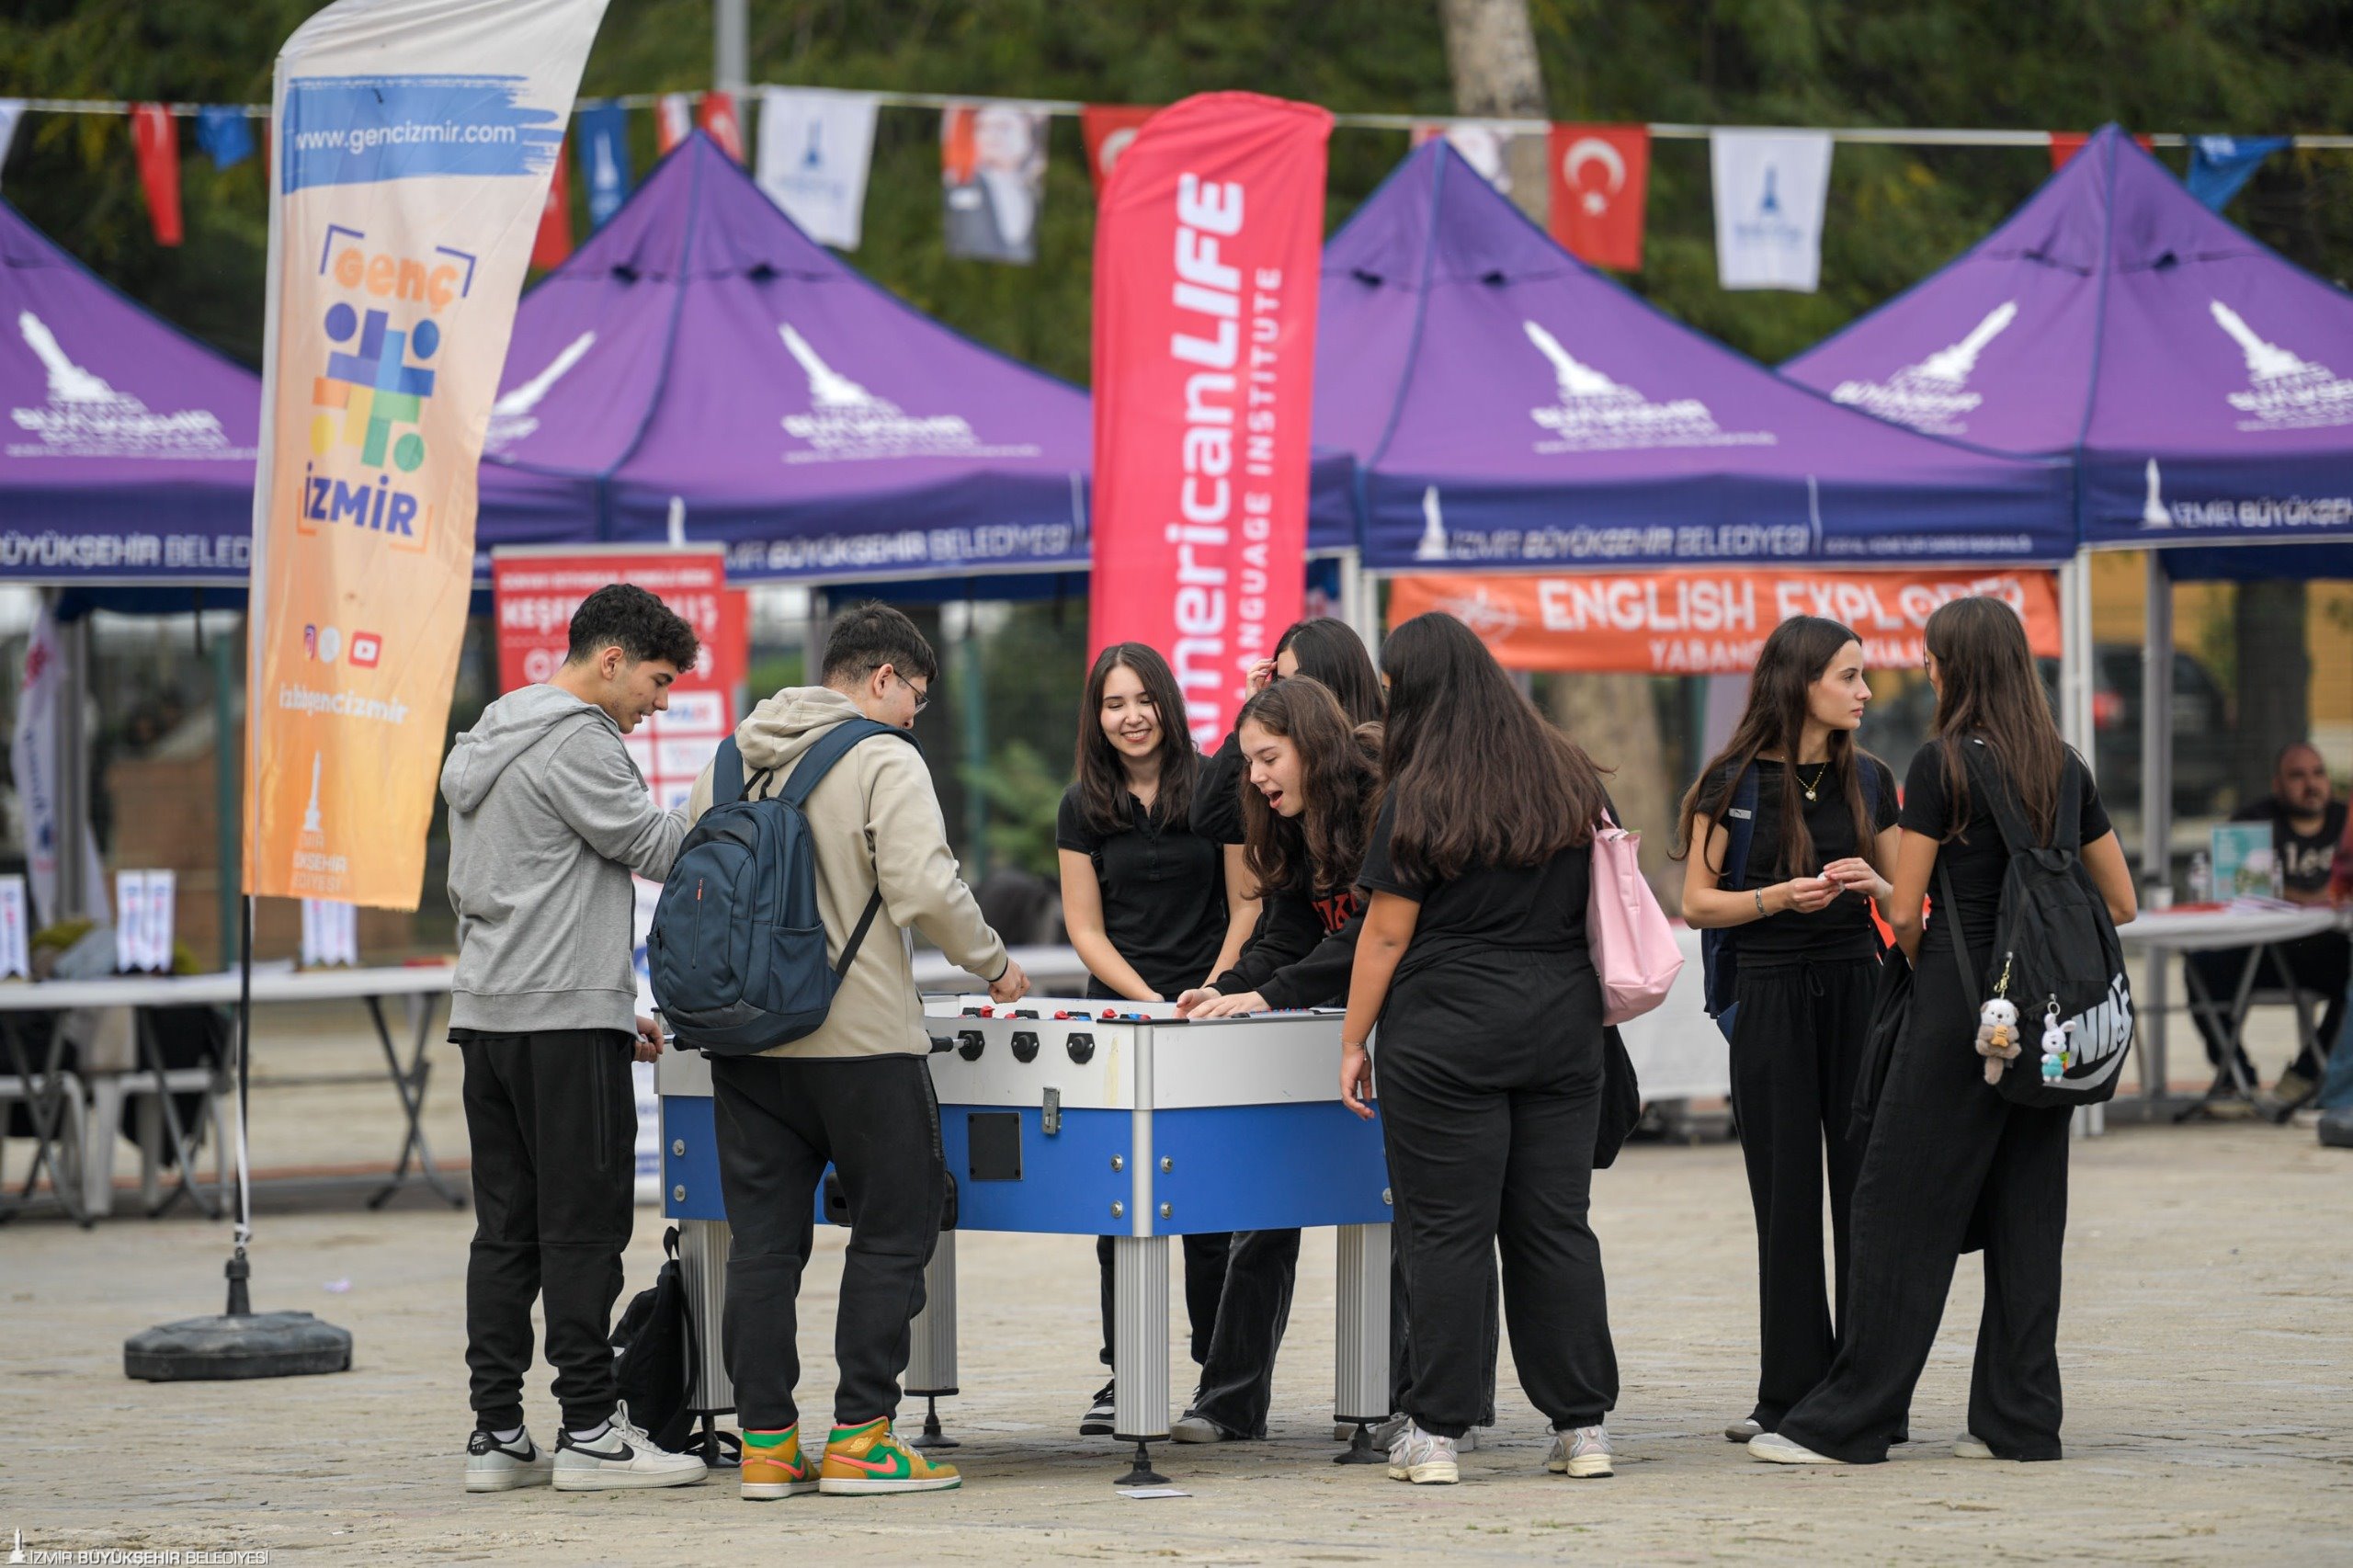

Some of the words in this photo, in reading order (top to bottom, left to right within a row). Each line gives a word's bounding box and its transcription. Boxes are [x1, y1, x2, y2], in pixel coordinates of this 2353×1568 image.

[295, 119, 517, 154] www.gencizmir.com
[1245, 267, 1283, 476] INSTITUTE
[303, 460, 418, 537] İZMİR
[1164, 171, 1245, 752] mericanLIFE
[0, 528, 162, 569] ÜYÜKŞEHİR
[1234, 493, 1272, 699] ANGUAGE
[1537, 578, 1757, 632] ENGLISH
